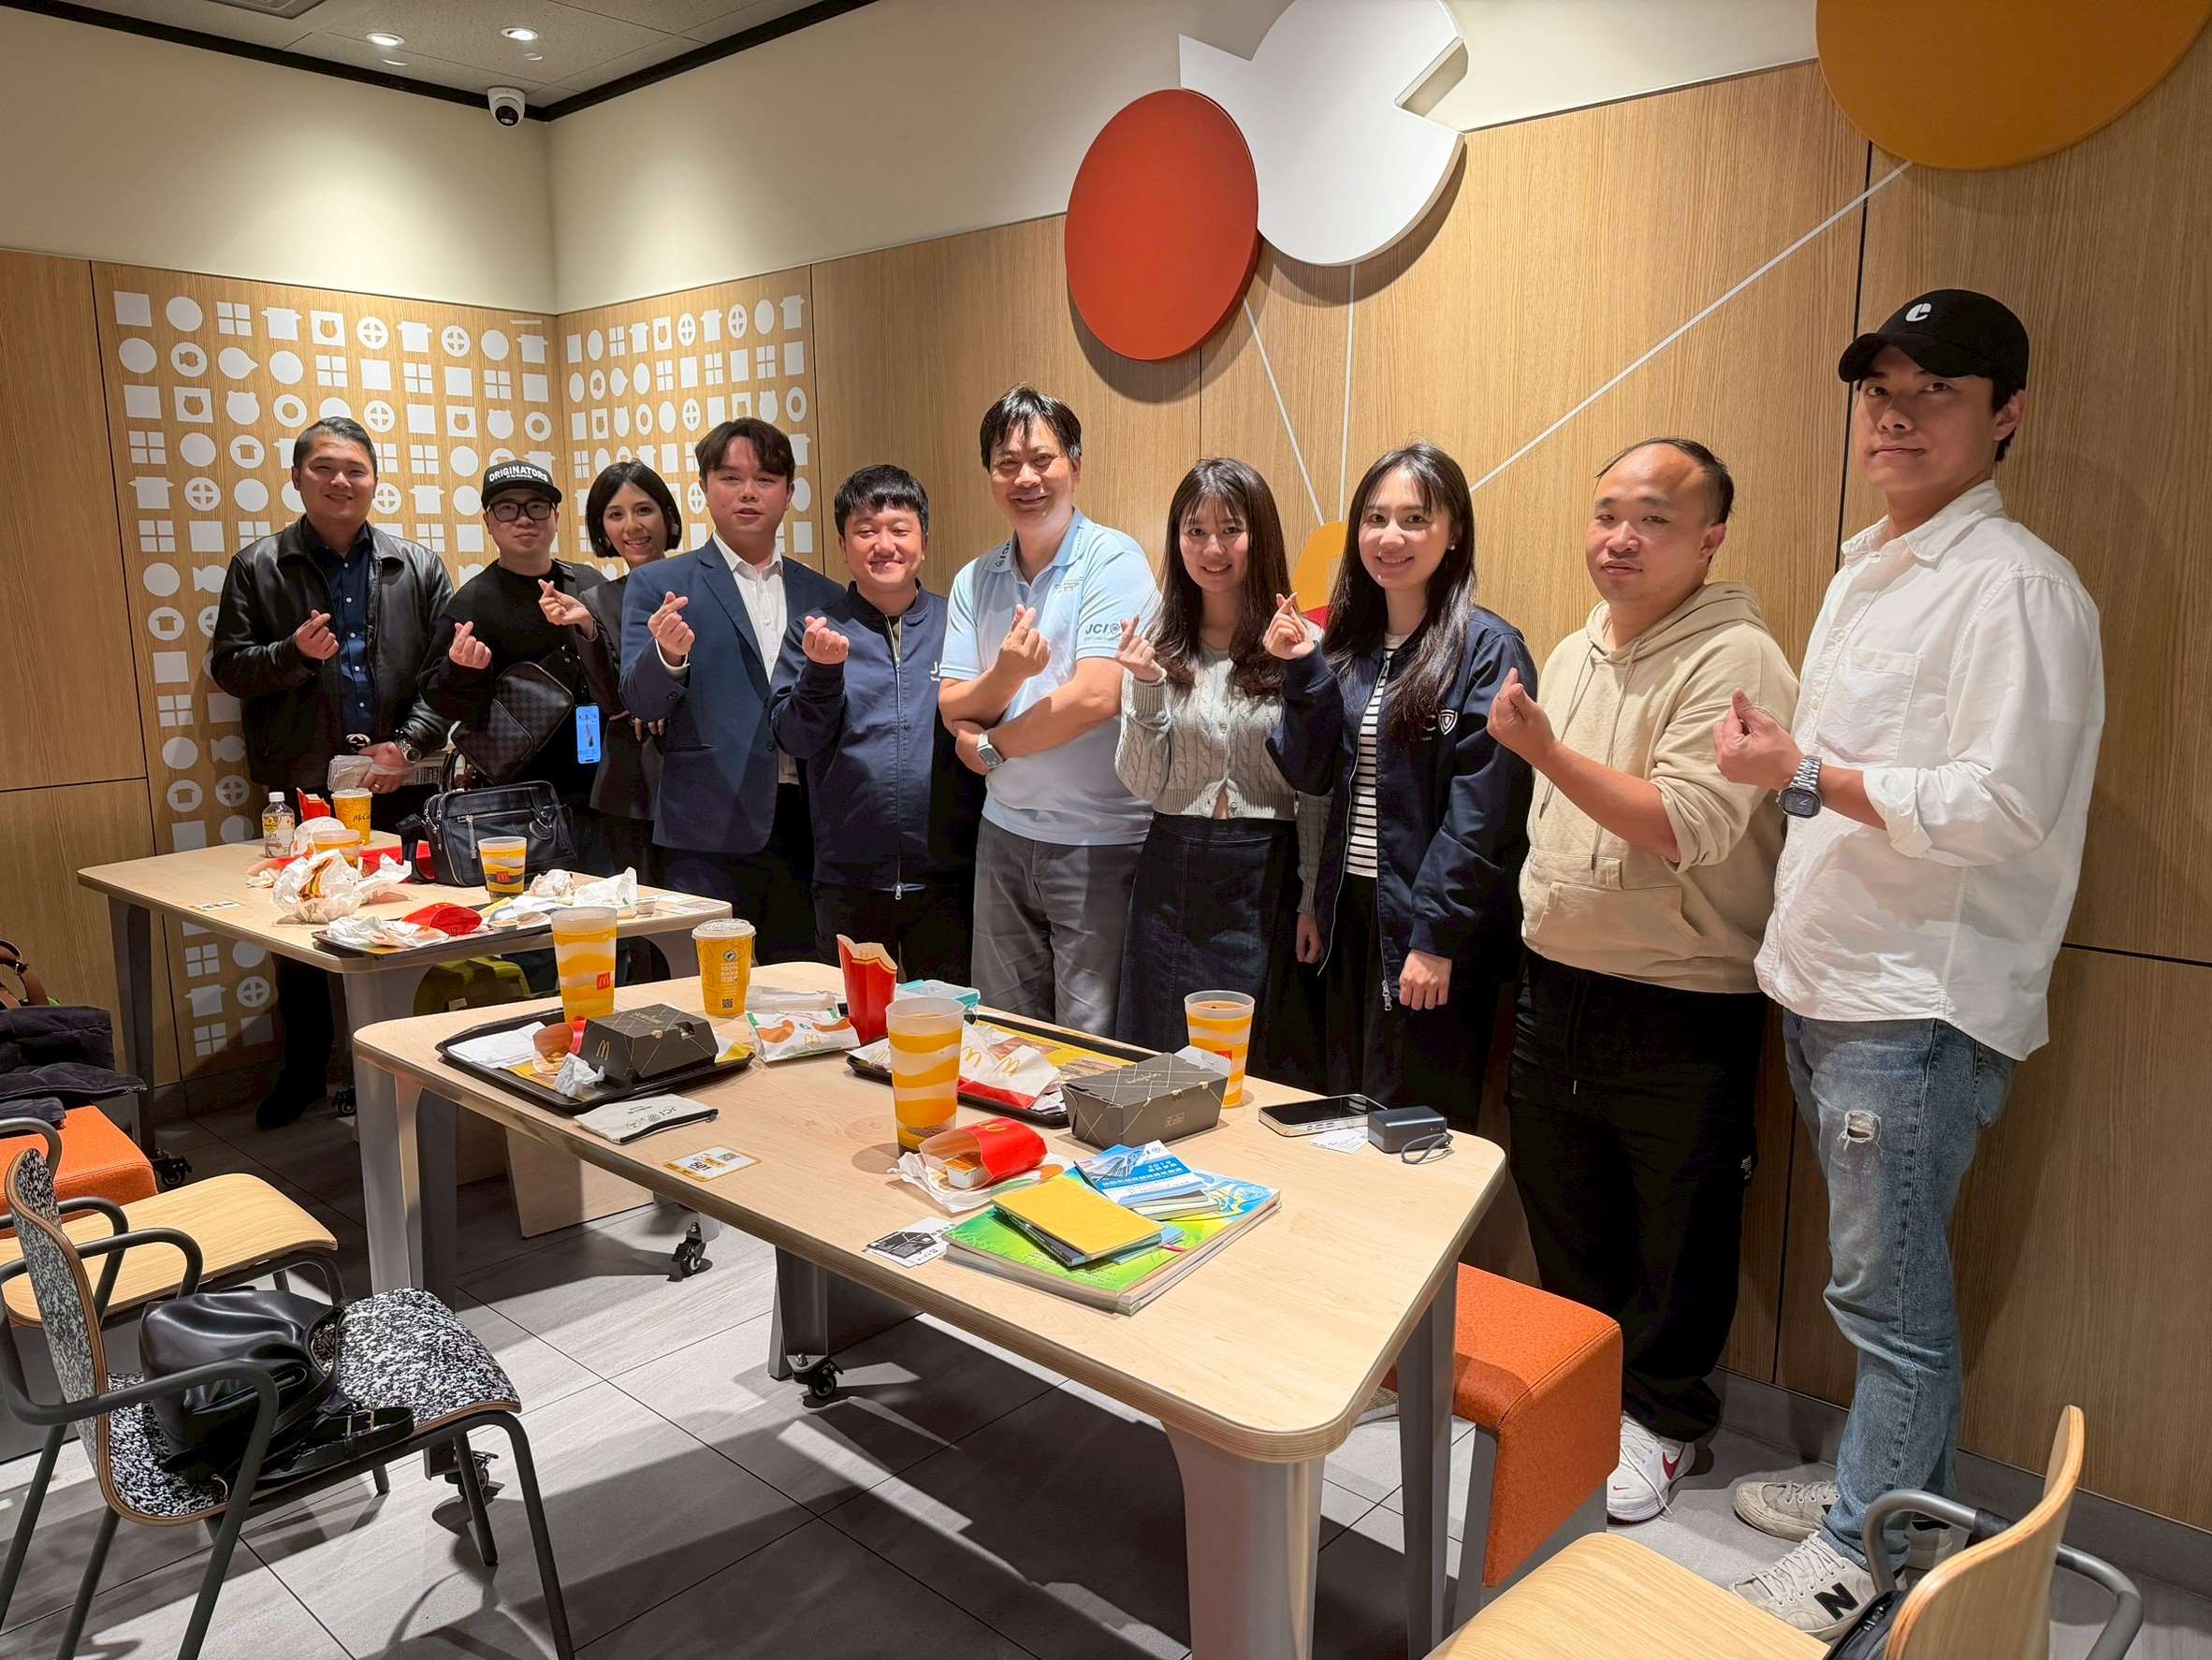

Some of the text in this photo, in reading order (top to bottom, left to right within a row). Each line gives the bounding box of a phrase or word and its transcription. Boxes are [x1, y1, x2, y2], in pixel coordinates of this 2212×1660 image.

[488, 465, 549, 483] ORIGINATORS
[1084, 623, 1109, 634] JCI
[690, 1161, 712, 1171] 501
[1813, 1581, 1859, 1621] N
